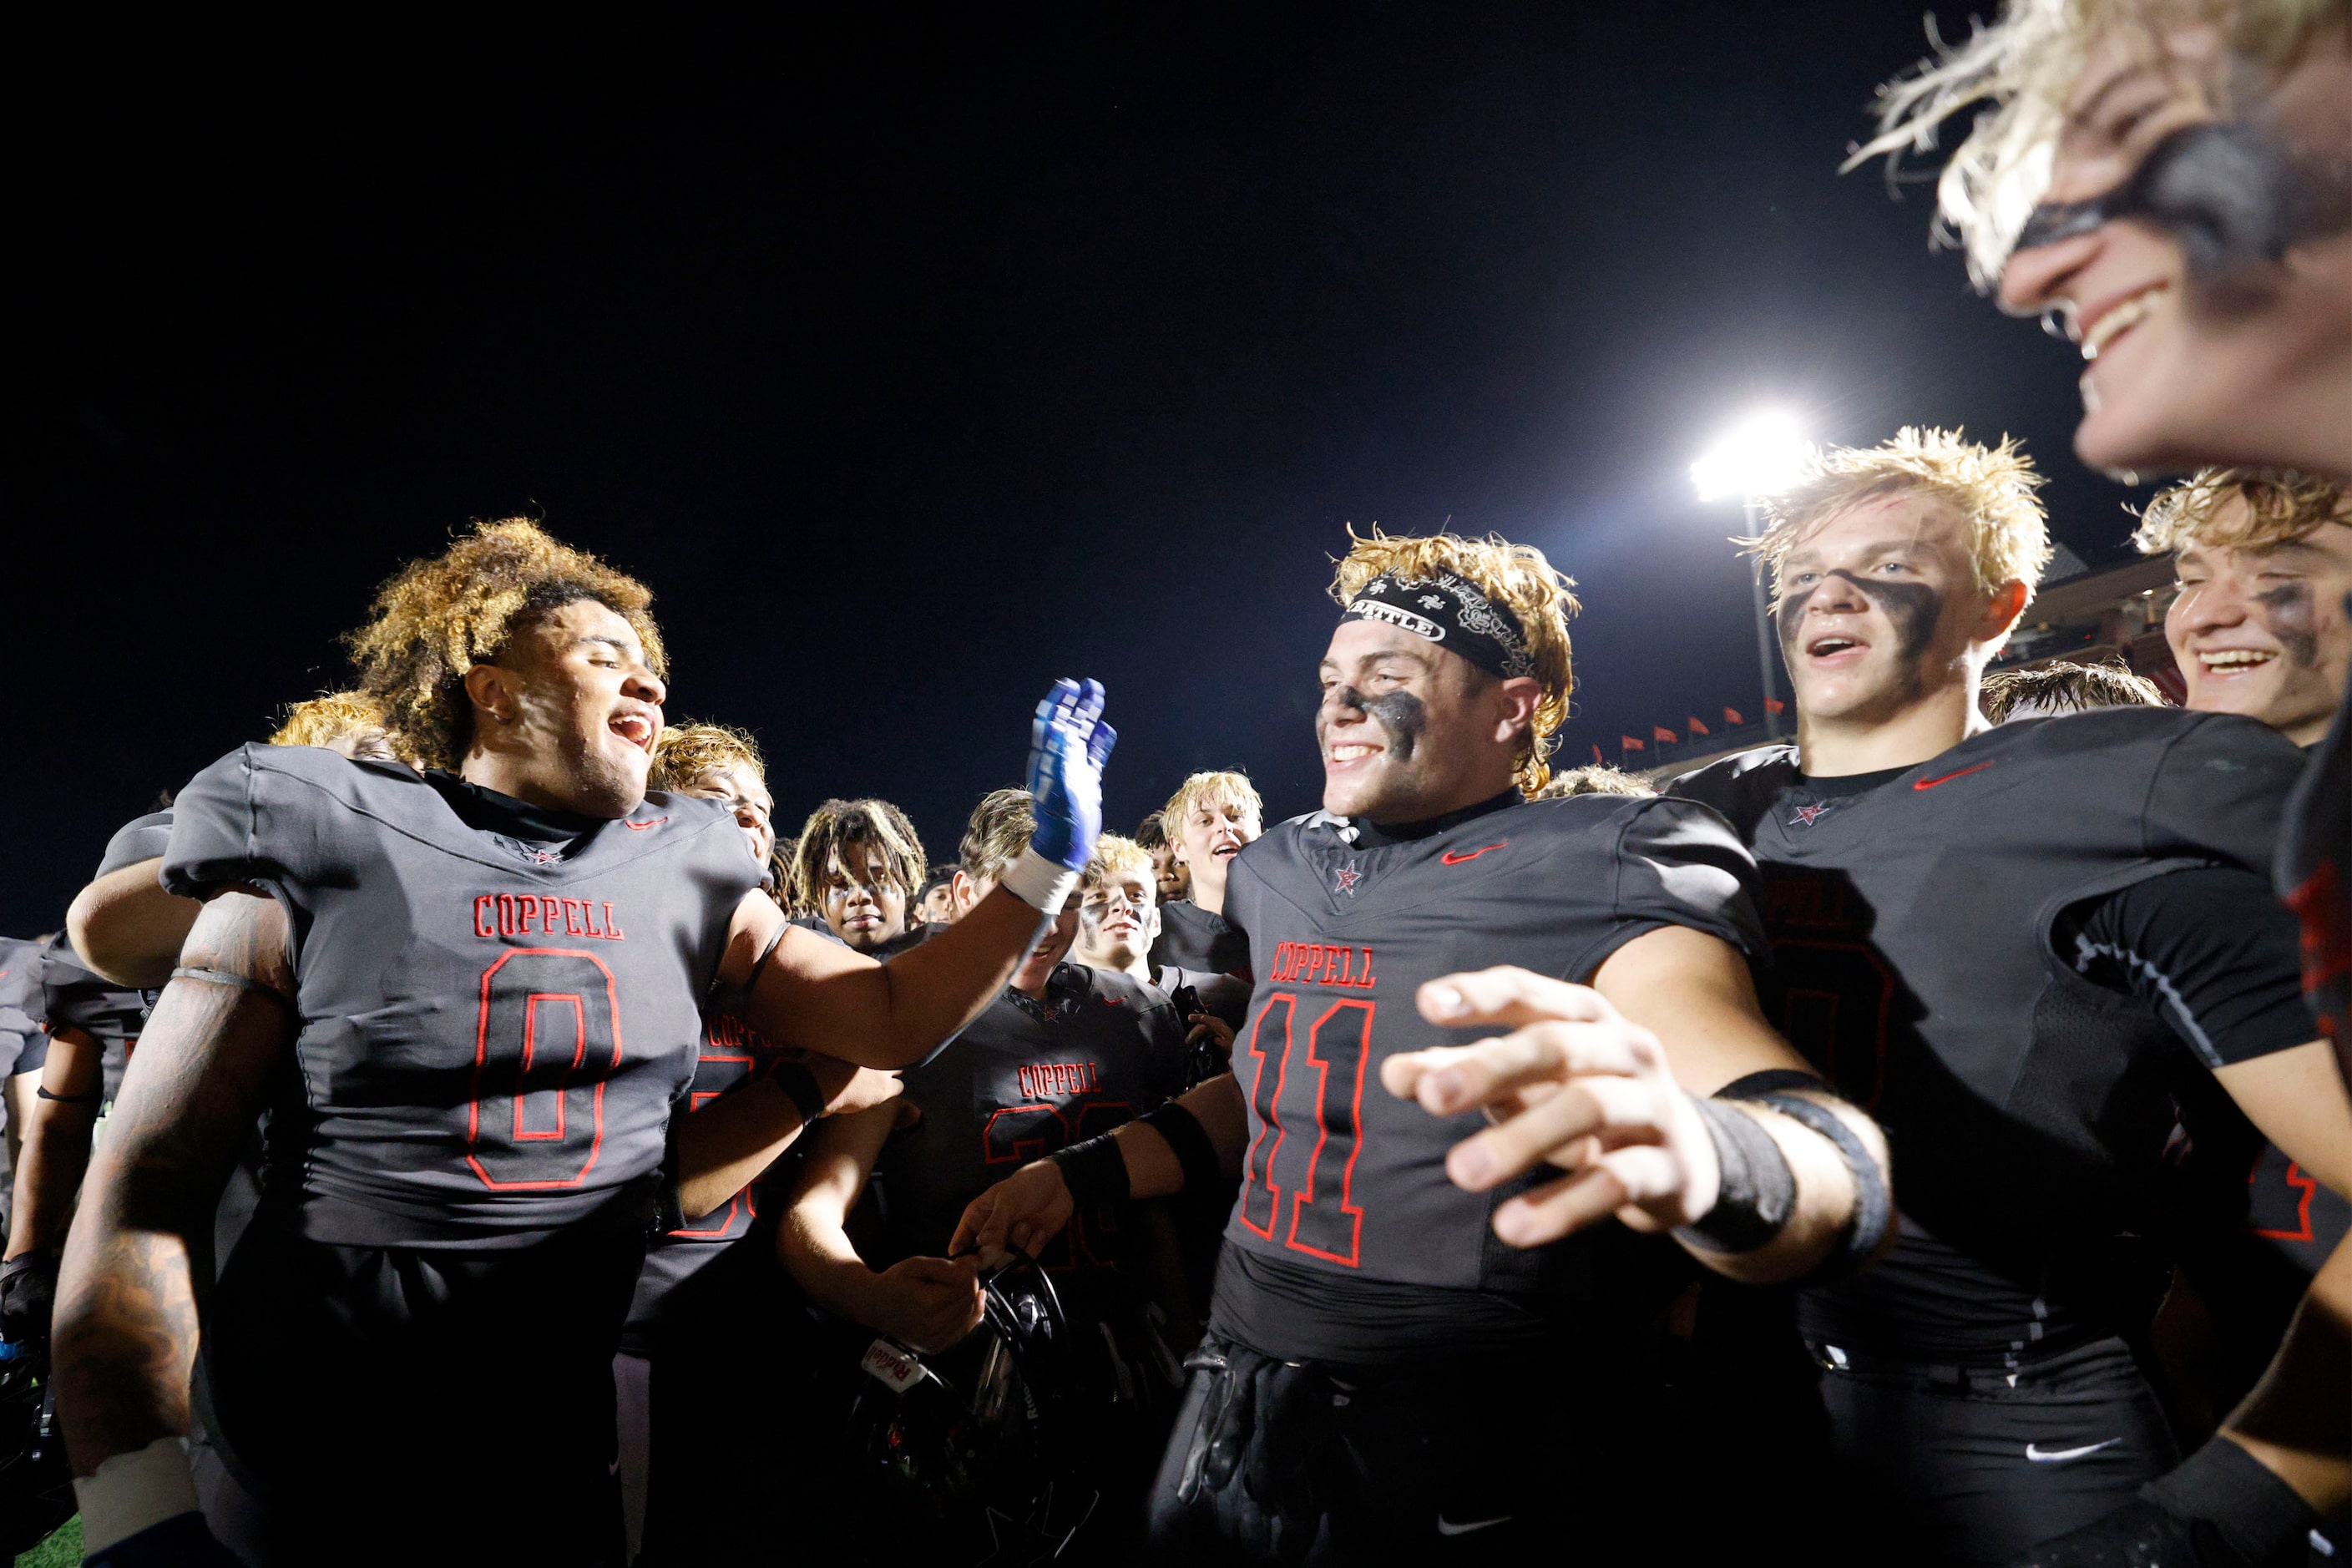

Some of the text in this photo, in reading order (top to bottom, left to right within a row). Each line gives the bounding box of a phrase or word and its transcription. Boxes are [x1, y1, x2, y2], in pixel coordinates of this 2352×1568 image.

[1350, 600, 1434, 637] BATTLE
[473, 893, 625, 941] COPPELL
[1269, 941, 1378, 989] COPPELL
[466, 947, 623, 1191] 0
[1018, 1062, 1104, 1097] COPPELL
[1239, 993, 1377, 1268] 11
